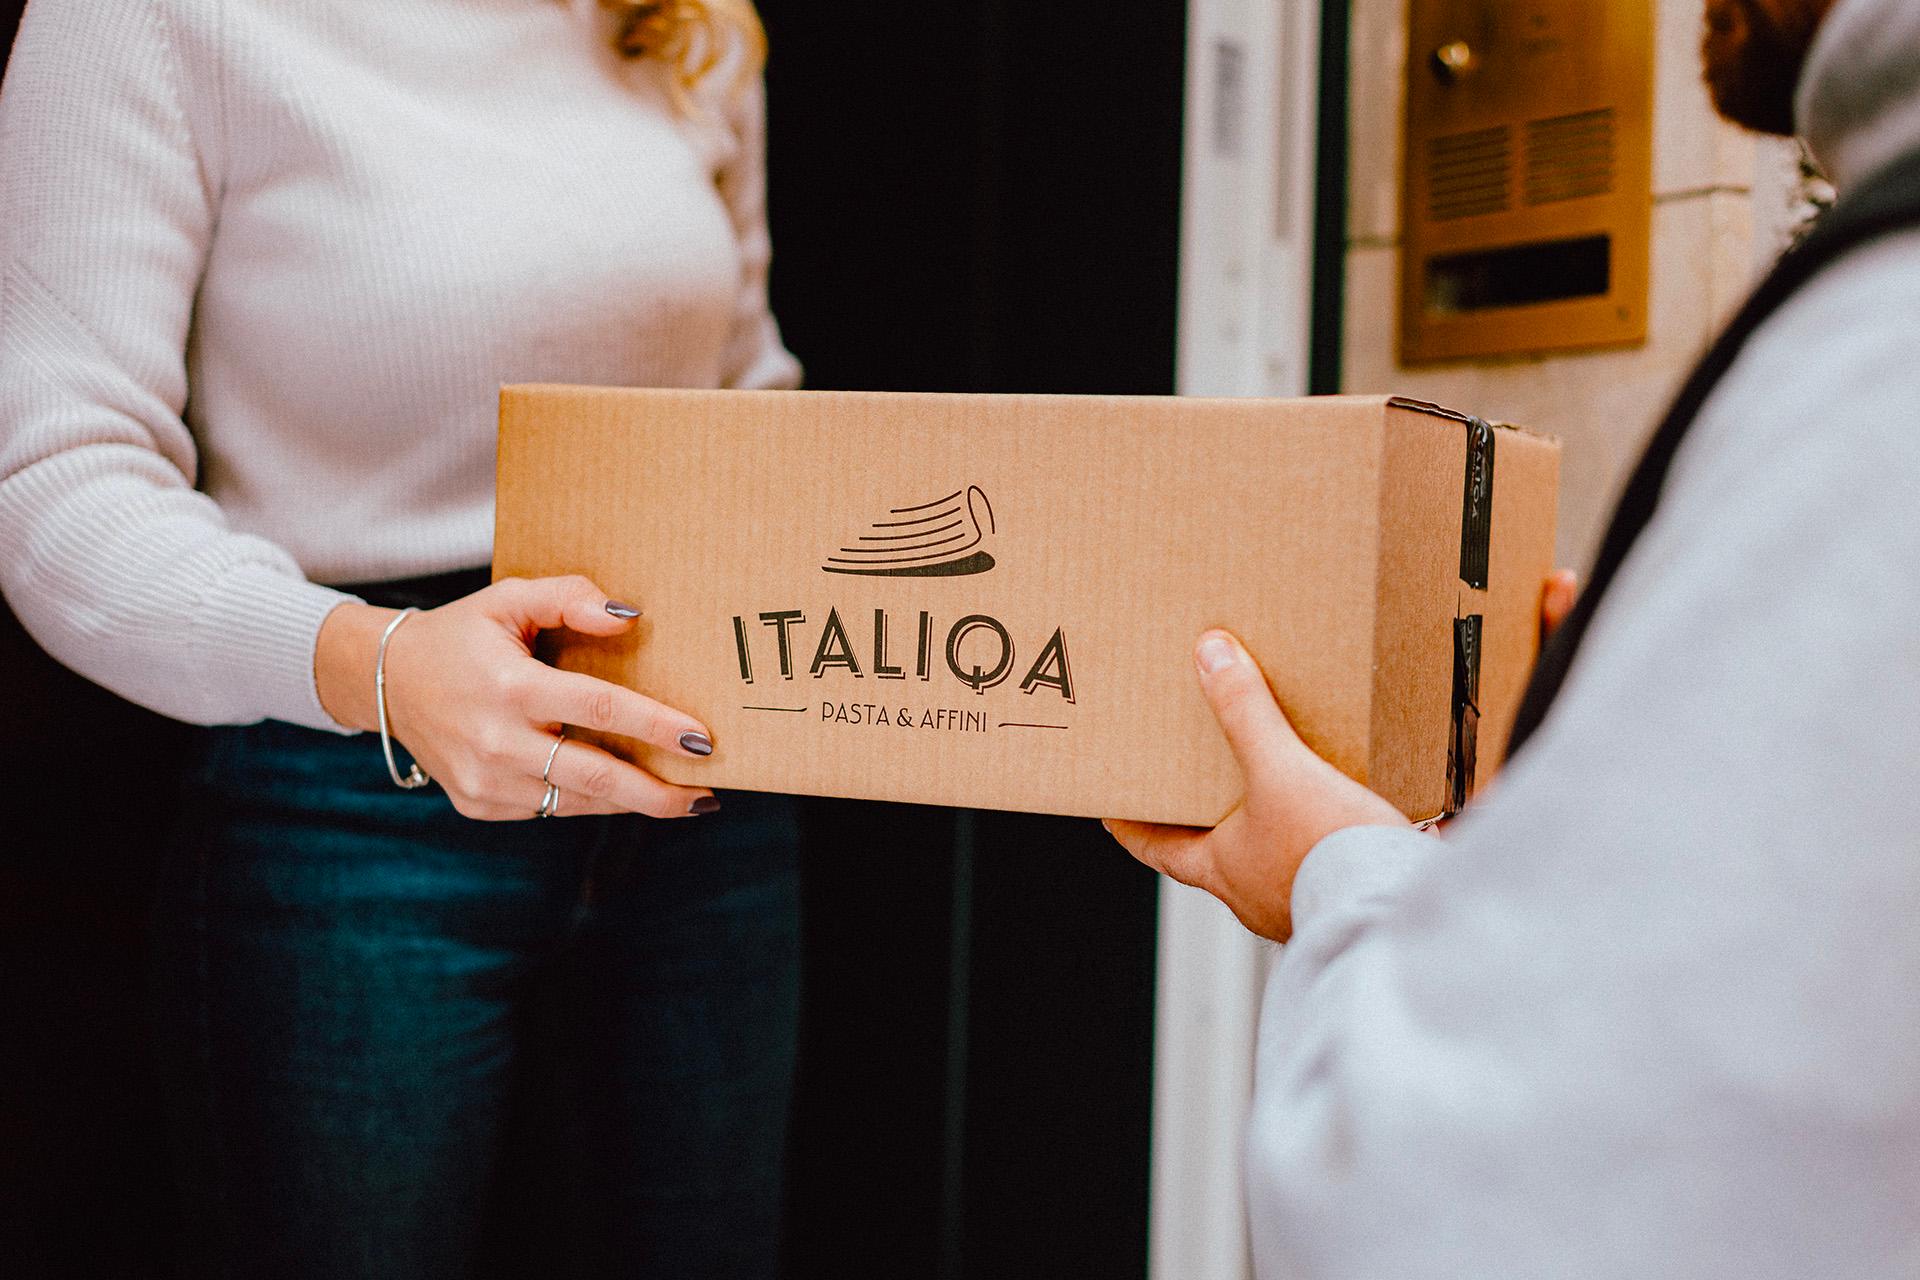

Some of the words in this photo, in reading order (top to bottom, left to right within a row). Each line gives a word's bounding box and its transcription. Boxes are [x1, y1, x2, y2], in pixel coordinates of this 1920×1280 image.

[733, 606, 1076, 704] ITALIQA
[822, 702, 889, 726] PASTA
[897, 708, 914, 727] &
[920, 709, 986, 732] AFFINI
